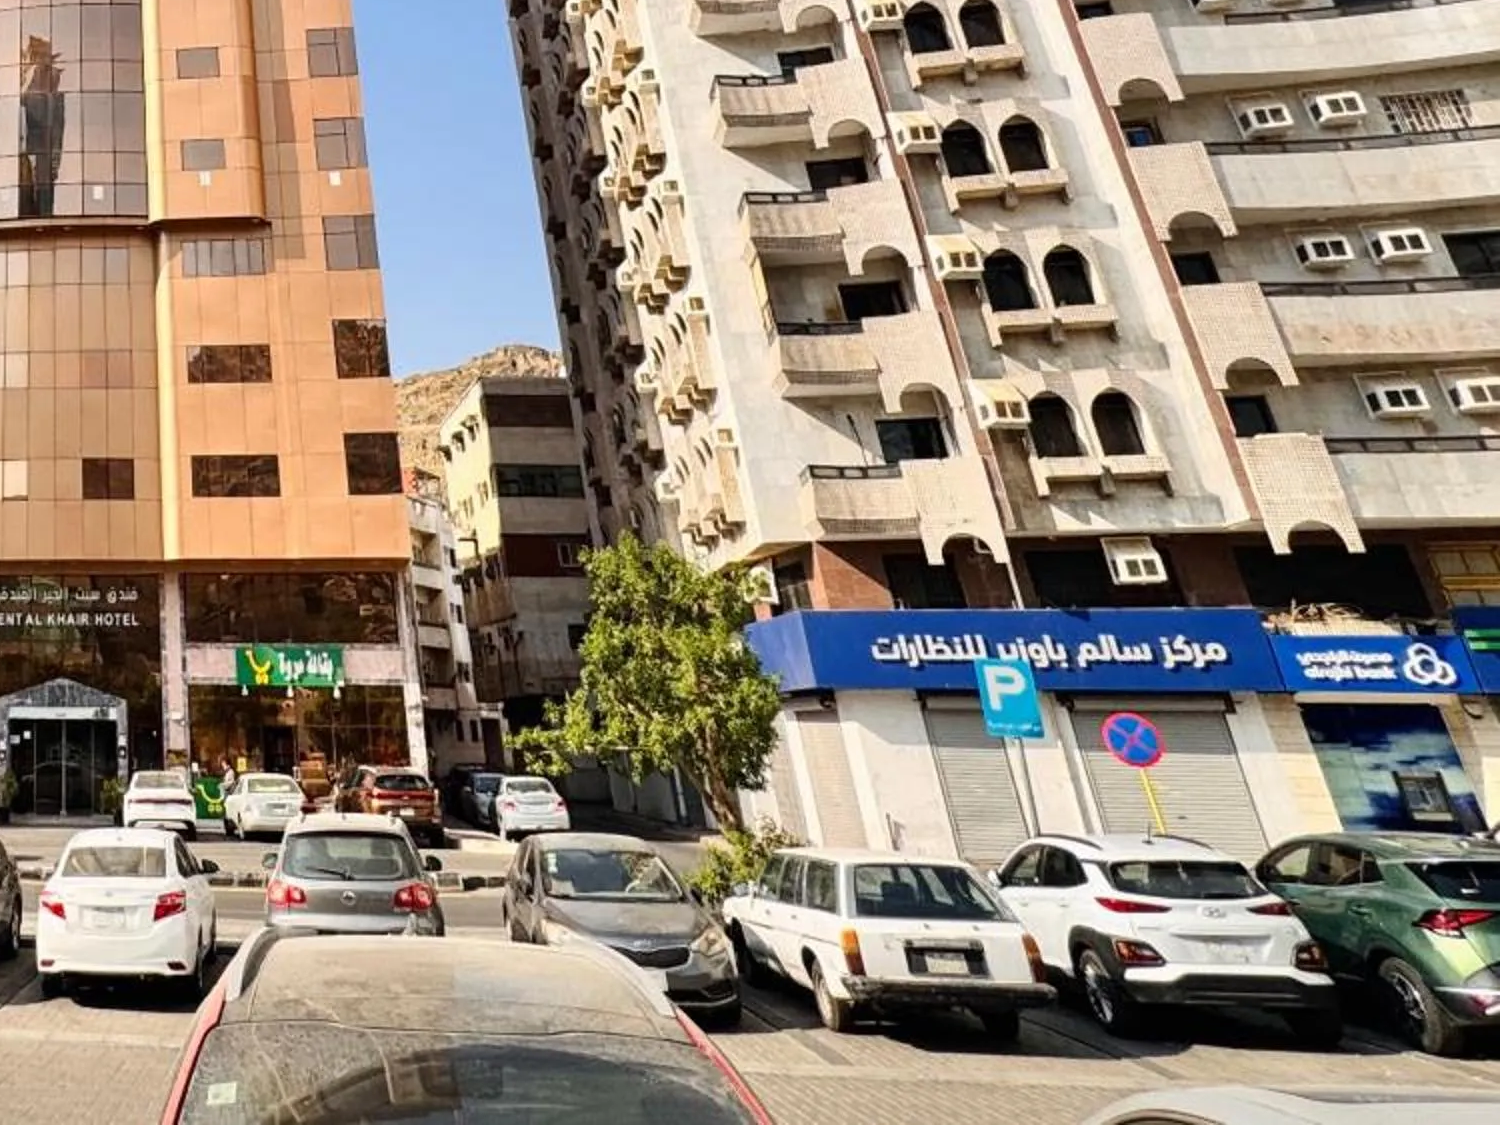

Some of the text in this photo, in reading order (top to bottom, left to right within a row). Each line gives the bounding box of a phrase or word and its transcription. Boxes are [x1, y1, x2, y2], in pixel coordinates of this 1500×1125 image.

[106, 586, 139, 604] فندق
[47, 612, 90, 626] KHAIR
[95, 612, 140, 626] HOTEL
[871, 633, 987, 668] للنظارات
[1077, 634, 1152, 668] سالم
[1159, 634, 1227, 669] مركز
[983, 664, 1027, 712] P
